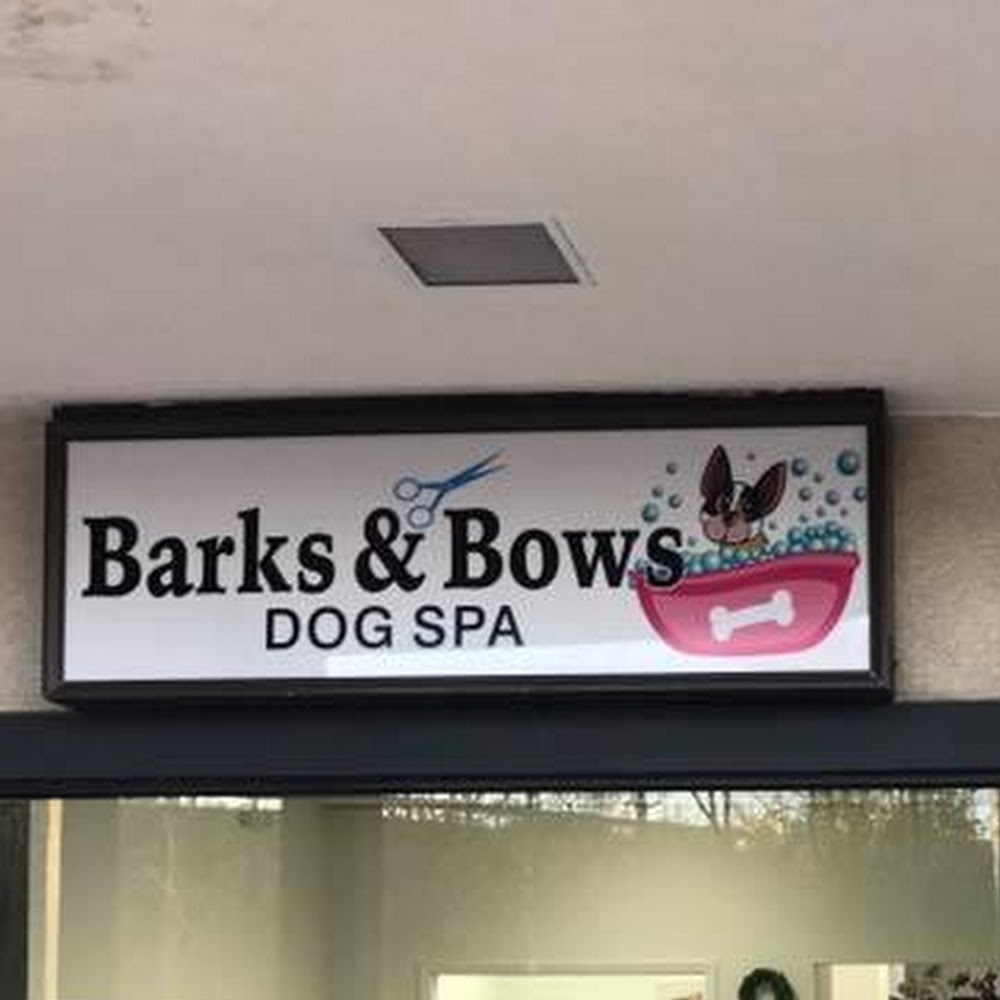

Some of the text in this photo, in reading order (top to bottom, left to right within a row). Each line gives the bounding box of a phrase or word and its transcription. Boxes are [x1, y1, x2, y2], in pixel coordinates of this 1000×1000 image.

[82, 507, 685, 598] Barks & Bows
[266, 603, 524, 650] DOG SPA
